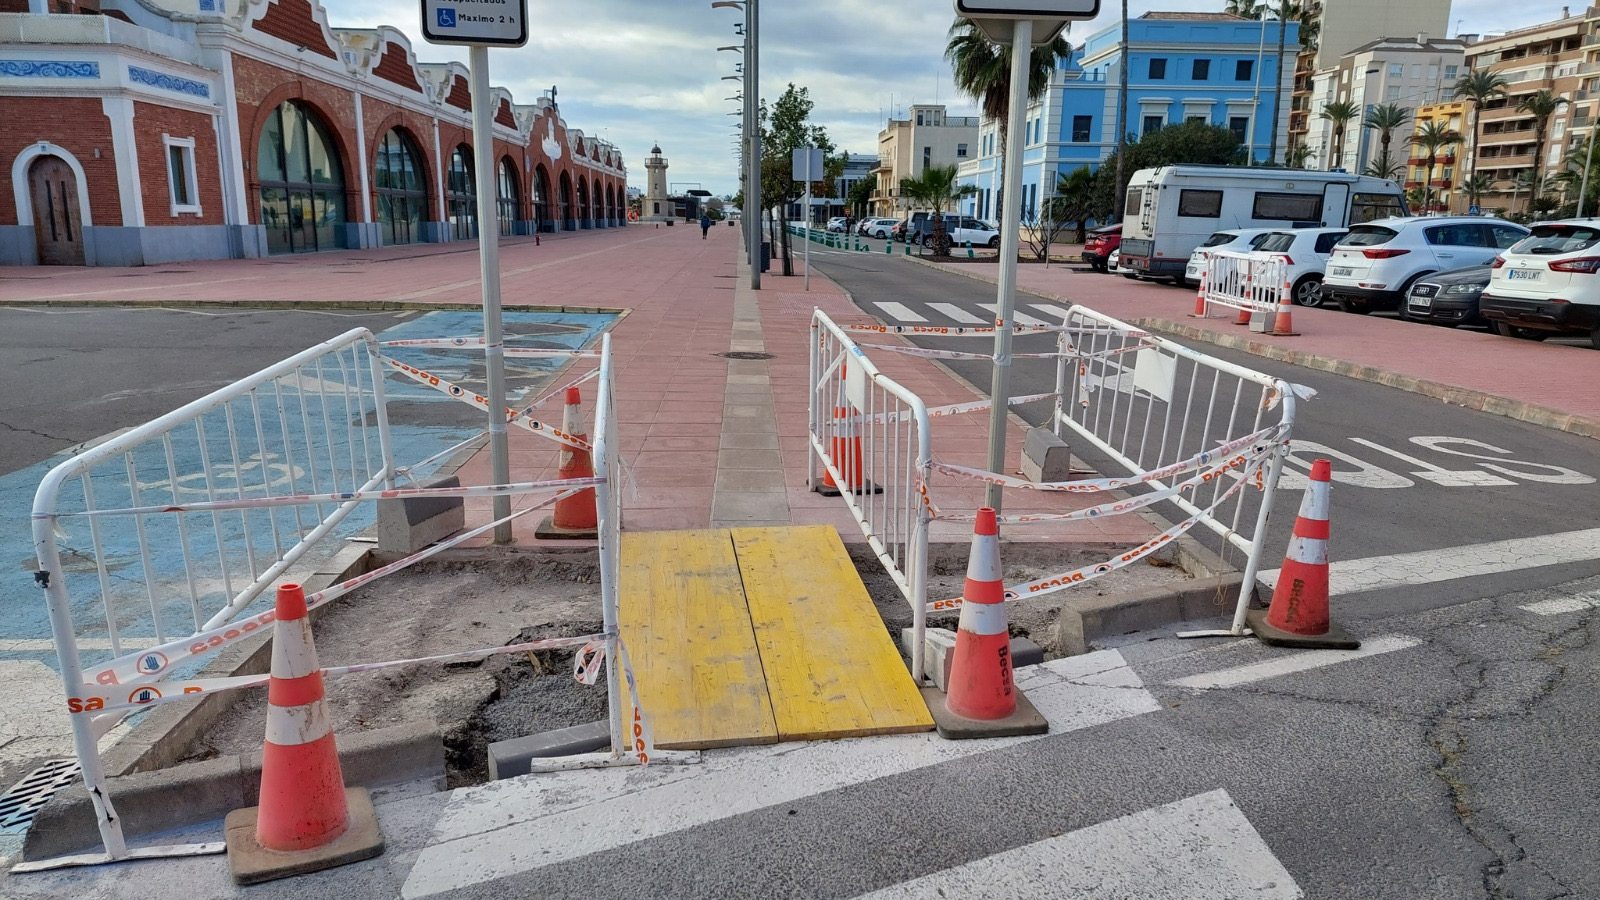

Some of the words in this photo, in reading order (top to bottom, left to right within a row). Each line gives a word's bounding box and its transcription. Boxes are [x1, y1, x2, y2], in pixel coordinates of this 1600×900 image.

[458, 14, 494, 23] Maximo
[499, 15, 505, 23] 2
[509, 16, 515, 24] h
[998, 645, 1011, 696] Becsa
